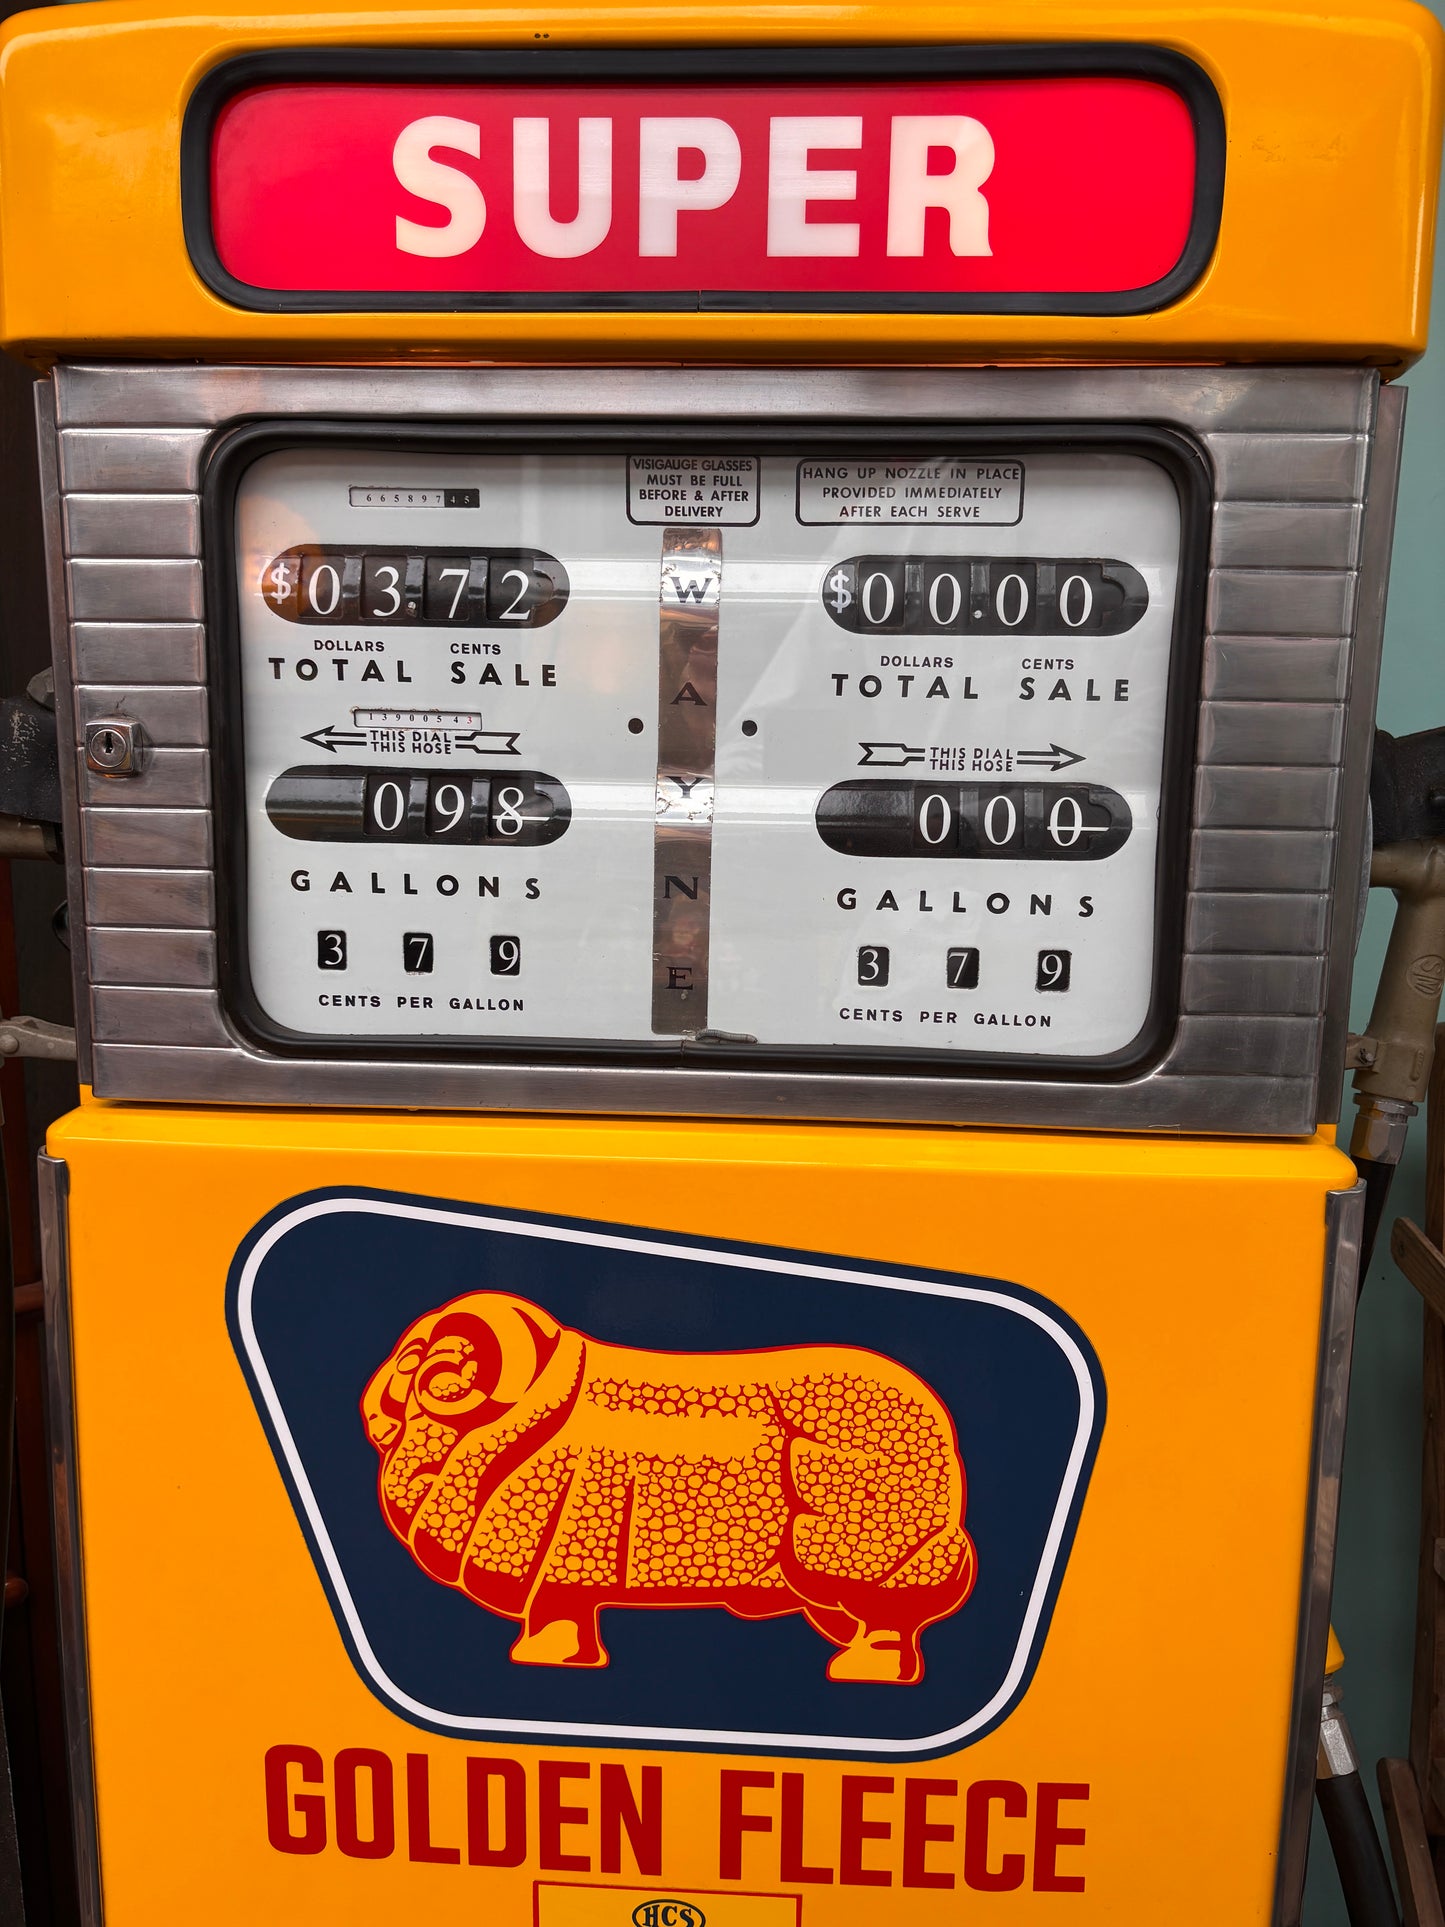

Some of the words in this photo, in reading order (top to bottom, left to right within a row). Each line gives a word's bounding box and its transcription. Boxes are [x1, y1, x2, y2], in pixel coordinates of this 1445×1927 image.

[393, 115, 995, 258] SUPER
[633, 458, 698, 471] VISIGAUGE
[701, 459, 752, 472] GLASSES
[646, 474, 682, 486] MUST
[690, 475, 706, 487] BE
[713, 475, 742, 487] FULL
[803, 467, 848, 479] HANG
[857, 467, 877, 479] UP
[885, 467, 941, 479] NOZZLE
[951, 468, 967, 480] IN
[977, 468, 1020, 480] PLACE
[639, 489, 687, 501] BEFORE
[694, 490, 703, 501] &
[710, 490, 749, 502] AFTER
[823, 487, 896, 499] PROVIDED
[905, 487, 1002, 499] IMMEDIATELY
[664, 506, 723, 518] DELIVERY
[839, 505, 881, 518] AFTER
[891, 506, 927, 518] EACH
[937, 506, 980, 518] SERVE
[314, 640, 385, 652] DOLLARS
[450, 643, 501, 655] CENTS
[880, 655, 954, 668] DOLLARS
[1022, 658, 1075, 671] CENTS
[268, 657, 412, 683] TOTAL
[450, 661, 557, 687] SALE
[831, 673, 978, 700] TOTAL
[1019, 676, 1129, 702] SALE
[370, 730, 405, 742] THIS
[412, 731, 451, 743] DIAL
[370, 741, 405, 753] THIS
[412, 742, 451, 754] HOSE
[930, 747, 966, 759] THIS
[972, 748, 1013, 760] DIAL
[930, 759, 966, 771] THIS
[972, 759, 1013, 772] HOSE
[290, 869, 541, 900] GALLONS
[837, 888, 1094, 917] GALLONS
[318, 994, 381, 1007] CENTS
[397, 996, 433, 1009] PER
[449, 998, 524, 1011] GALLON
[839, 1008, 903, 1022] CENTS
[920, 1011, 958, 1024] PER
[973, 1014, 1051, 1028] GALLON
[264, 1744, 662, 1876] GOLDEN
[719, 1768, 1090, 1893] FLEECE
[642, 1904, 695, 1927] HCS
